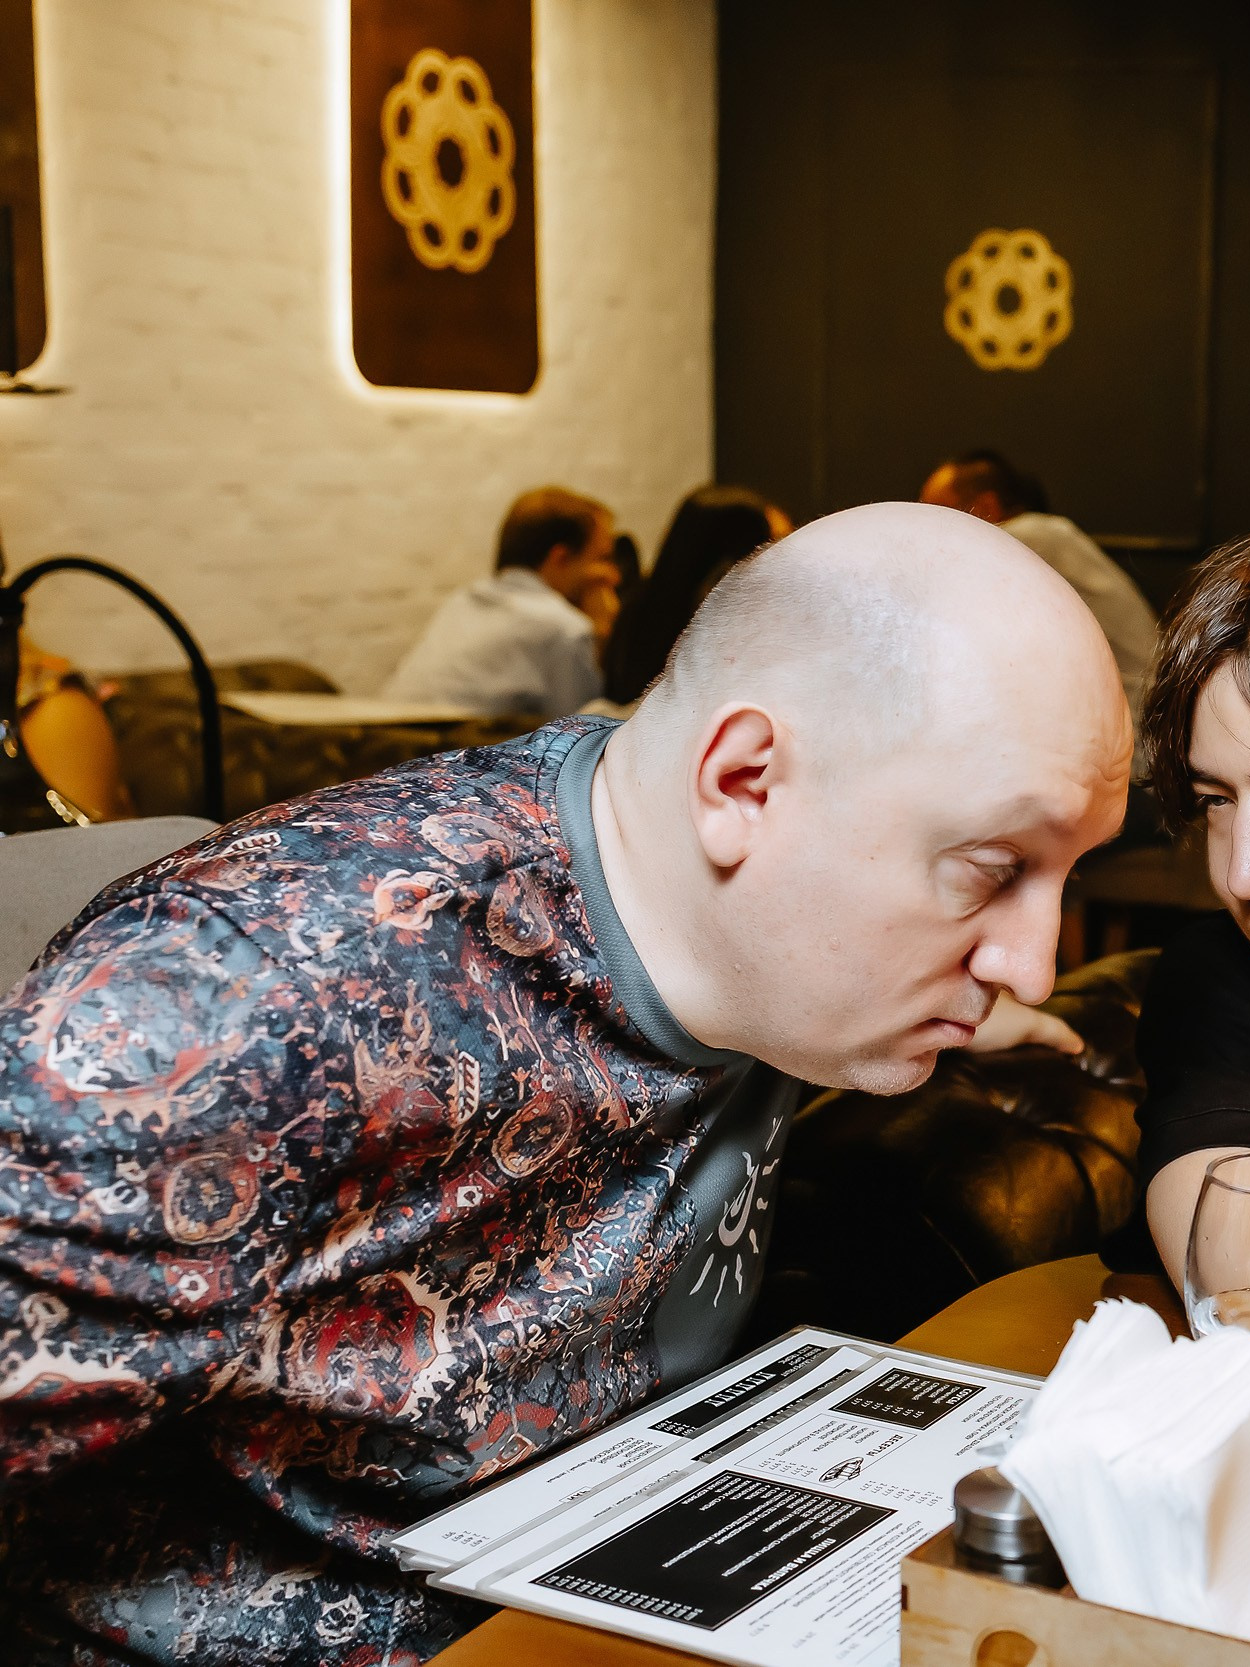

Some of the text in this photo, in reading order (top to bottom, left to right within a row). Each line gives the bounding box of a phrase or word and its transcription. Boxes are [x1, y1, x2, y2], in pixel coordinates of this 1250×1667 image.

[943, 1387, 974, 1405] СОУСЫ
[864, 1433, 905, 1457] ДЕСЕРТЫ
[798, 1537, 838, 1559] ПИЦЦА
[747, 1561, 800, 1591] ВЫПЕЧКА
